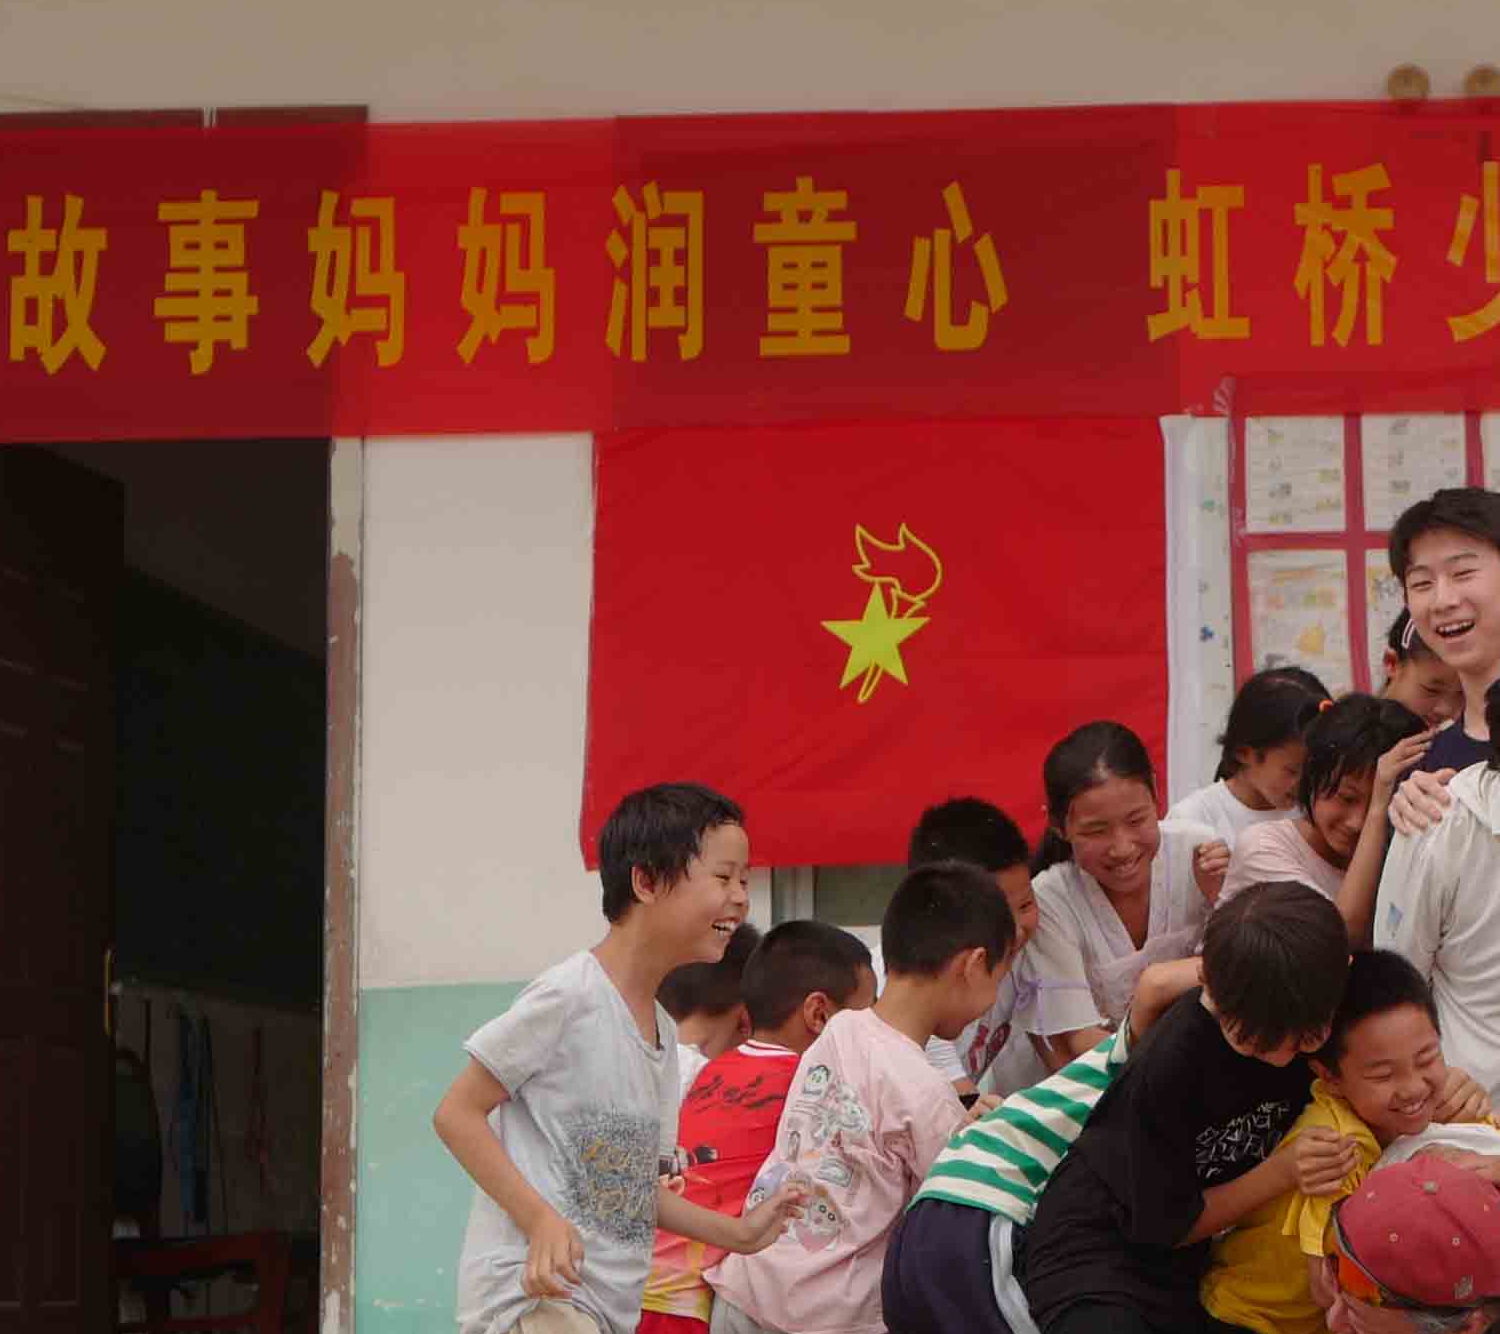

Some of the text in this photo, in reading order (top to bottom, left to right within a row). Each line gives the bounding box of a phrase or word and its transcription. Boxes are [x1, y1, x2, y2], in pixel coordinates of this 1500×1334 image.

[6, 175, 1010, 376] 故事妈妈润童心
